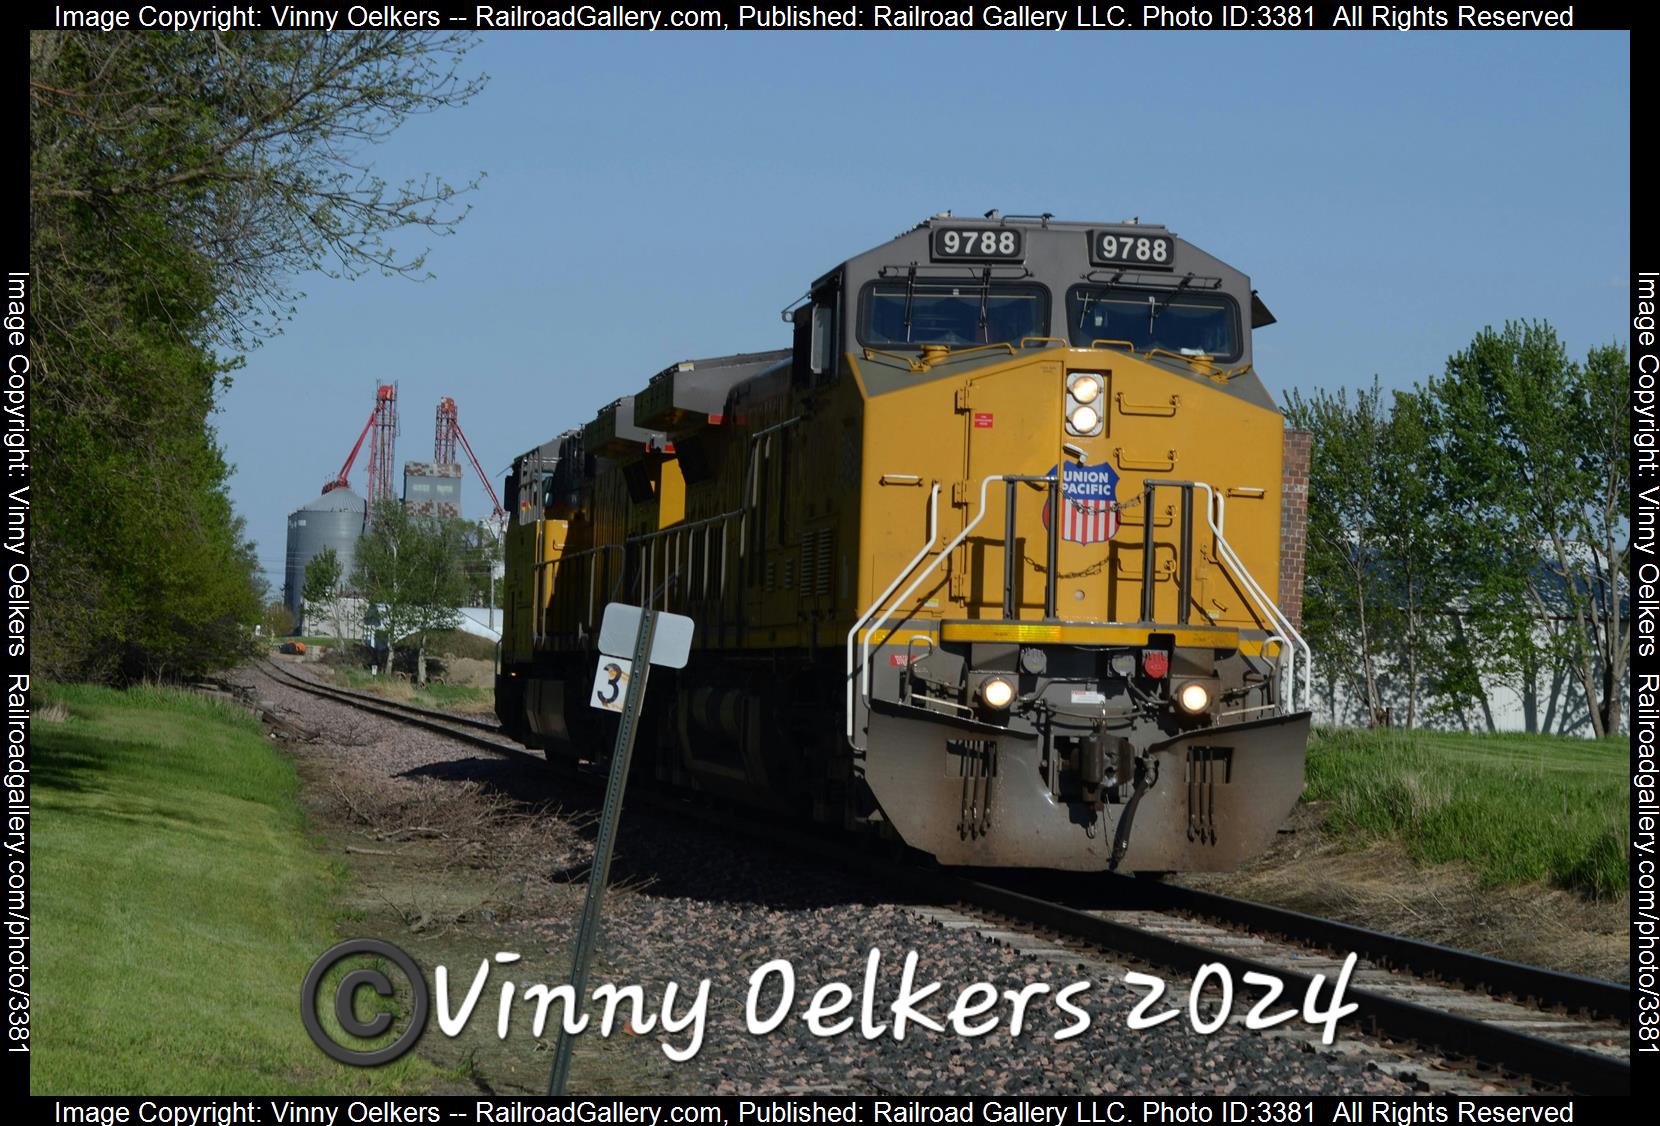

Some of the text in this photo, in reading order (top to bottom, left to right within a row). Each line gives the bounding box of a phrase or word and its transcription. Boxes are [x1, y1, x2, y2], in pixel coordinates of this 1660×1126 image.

[944, 231, 1015, 254] 9788
[1103, 235, 1167, 262] 9788
[1063, 471, 1109, 483] UNION
[1062, 483, 1111, 496] PACIFIC
[597, 663, 622, 704] 3
